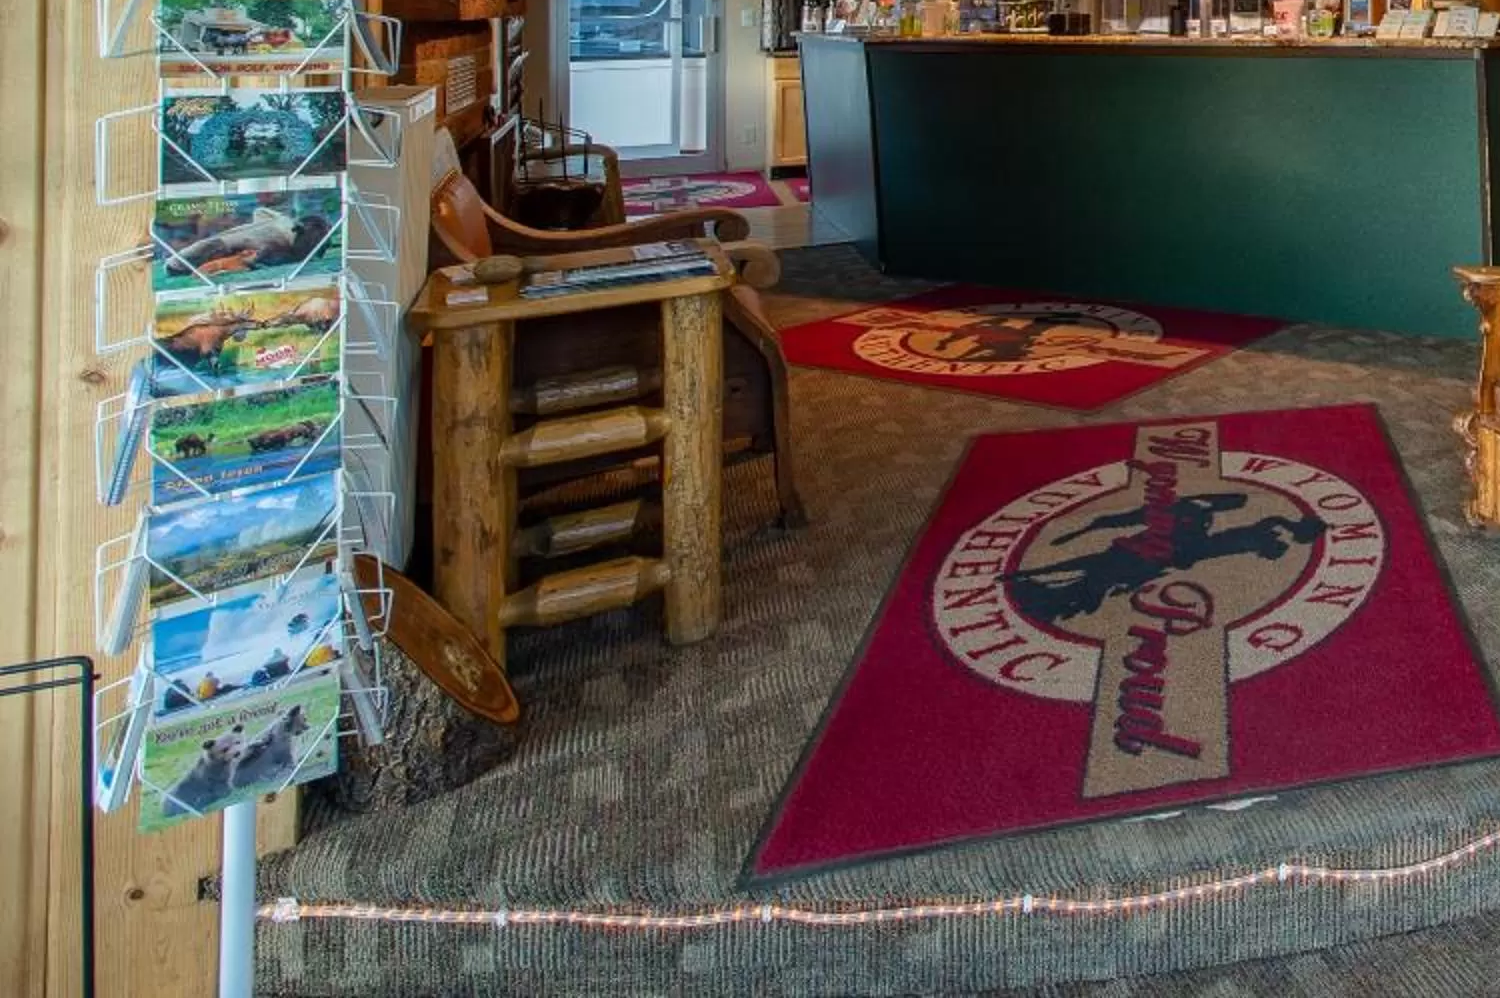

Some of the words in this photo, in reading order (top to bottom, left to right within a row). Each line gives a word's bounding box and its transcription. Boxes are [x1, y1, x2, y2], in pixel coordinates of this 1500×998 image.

[943, 470, 1102, 683] AUTHENTIC
[1239, 457, 1379, 652] WYOMING
[1114, 580, 1214, 759] Proud
